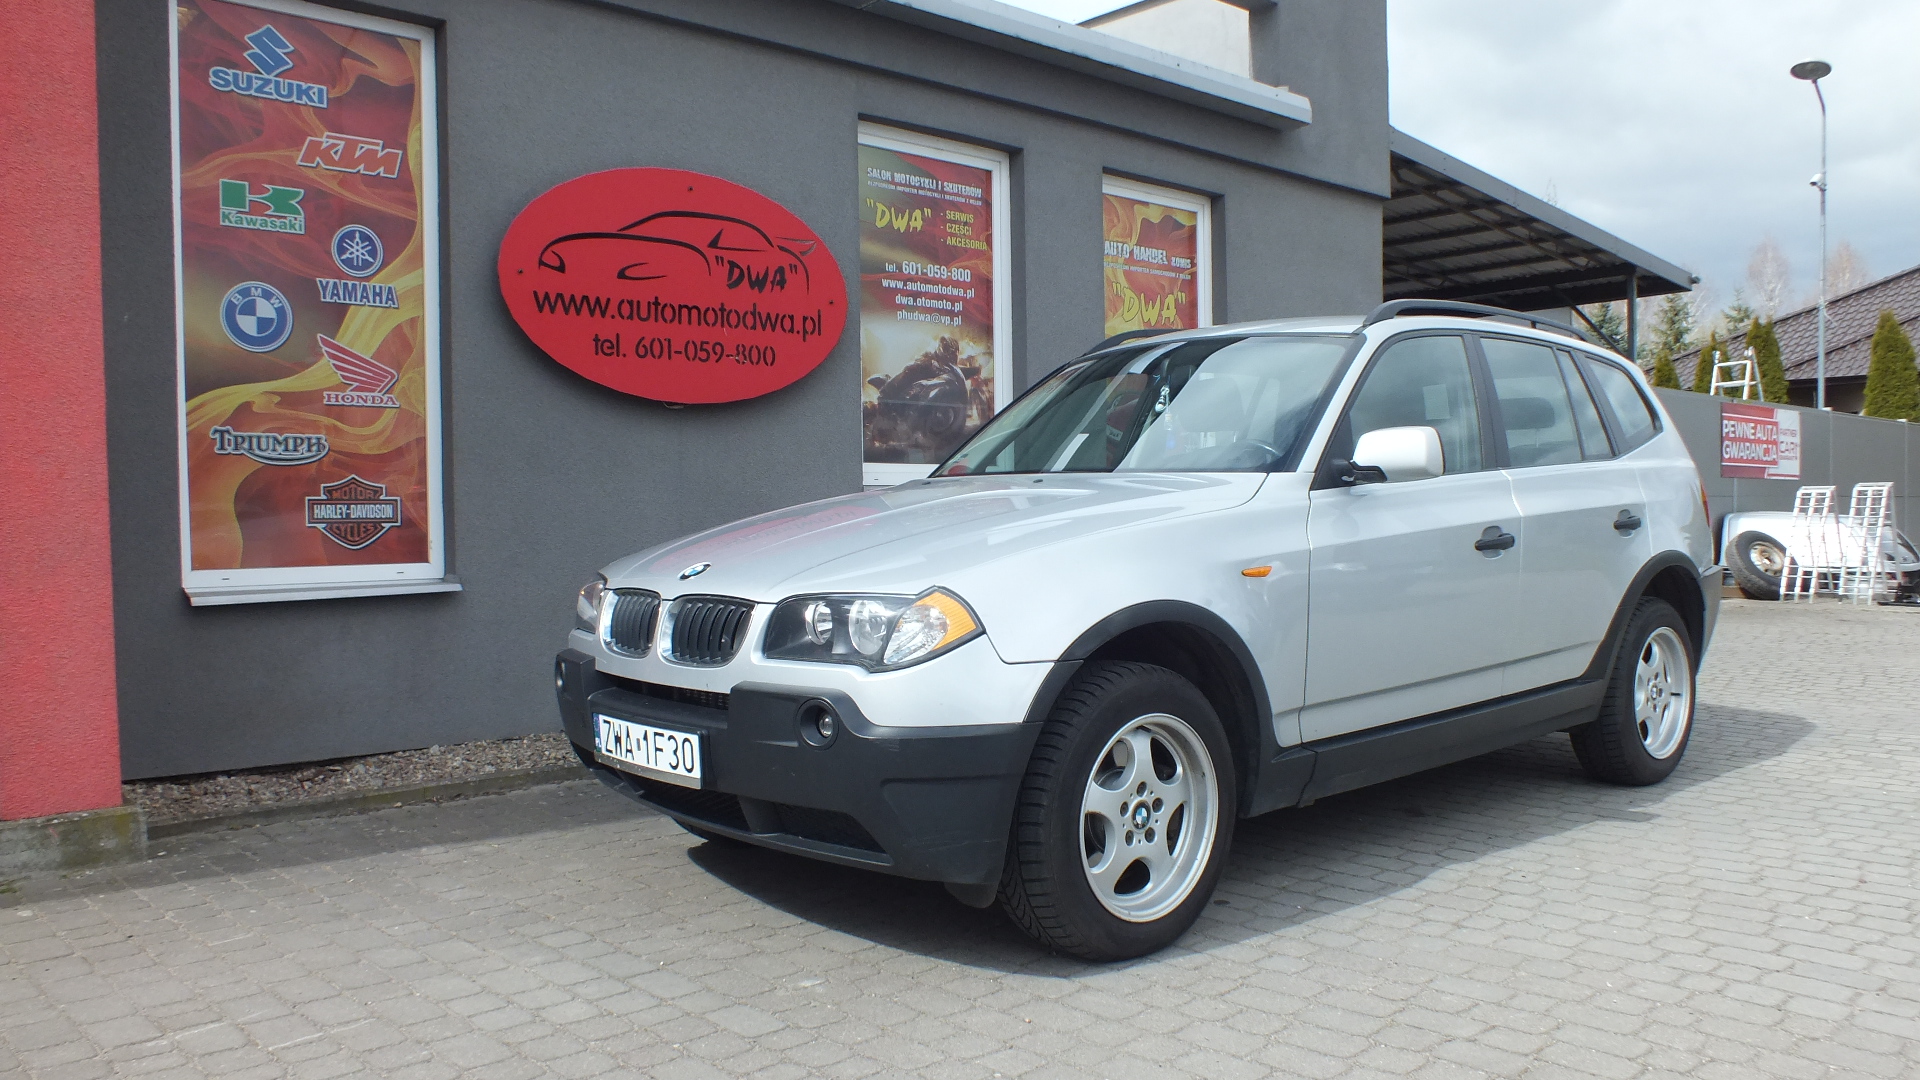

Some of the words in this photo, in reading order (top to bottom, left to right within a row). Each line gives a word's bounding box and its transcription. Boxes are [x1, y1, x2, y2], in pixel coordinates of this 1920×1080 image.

[209, 67, 327, 107] SUZUKI
[297, 132, 402, 178] KTM
[867, 167, 892, 182] SALON
[894, 173, 937, 190] MOTOCYKLI
[938, 180, 942, 191] I
[943, 181, 982, 198] SKUTERÓW
[221, 211, 304, 233] Kawasaki
[866, 198, 932, 233] "DWA"
[946, 210, 974, 223] SERWIS
[946, 222, 972, 236] CZĘŚCI
[946, 238, 988, 250] AKCESORIA
[1104, 241, 1130, 259] AUTO
[1133, 245, 1168, 264] HANDEL
[715, 255, 798, 293] "DWA"
[885, 262, 899, 273] tel.
[902, 261, 971, 282] 601-059-800
[230, 287, 283, 308] BMW
[317, 278, 398, 307] YAMAHA
[882, 278, 975, 298] www.automotodwa.pl
[895, 294, 963, 313] dwa.otomoto.pl
[1112, 282, 1186, 326] "DWA"
[533, 290, 822, 342] www.automotodwa.pl
[897, 310, 962, 327] phudwa@vp.pl
[593, 333, 627, 358] tel.
[635, 337, 776, 367] 601-059-800
[324, 392, 399, 406] HONDA
[1722, 420, 1755, 439] PEWNE
[1756, 424, 1778, 441] AUTA
[1722, 441, 1778, 461] GWARANCJA
[331, 484, 374, 499] MOTOR
[313, 504, 393, 518] HARLEY-DAVIDSON
[333, 523, 375, 540] CYCLES
[603, 719, 634, 761] ZWA
[643, 730, 695, 774] 1F30
